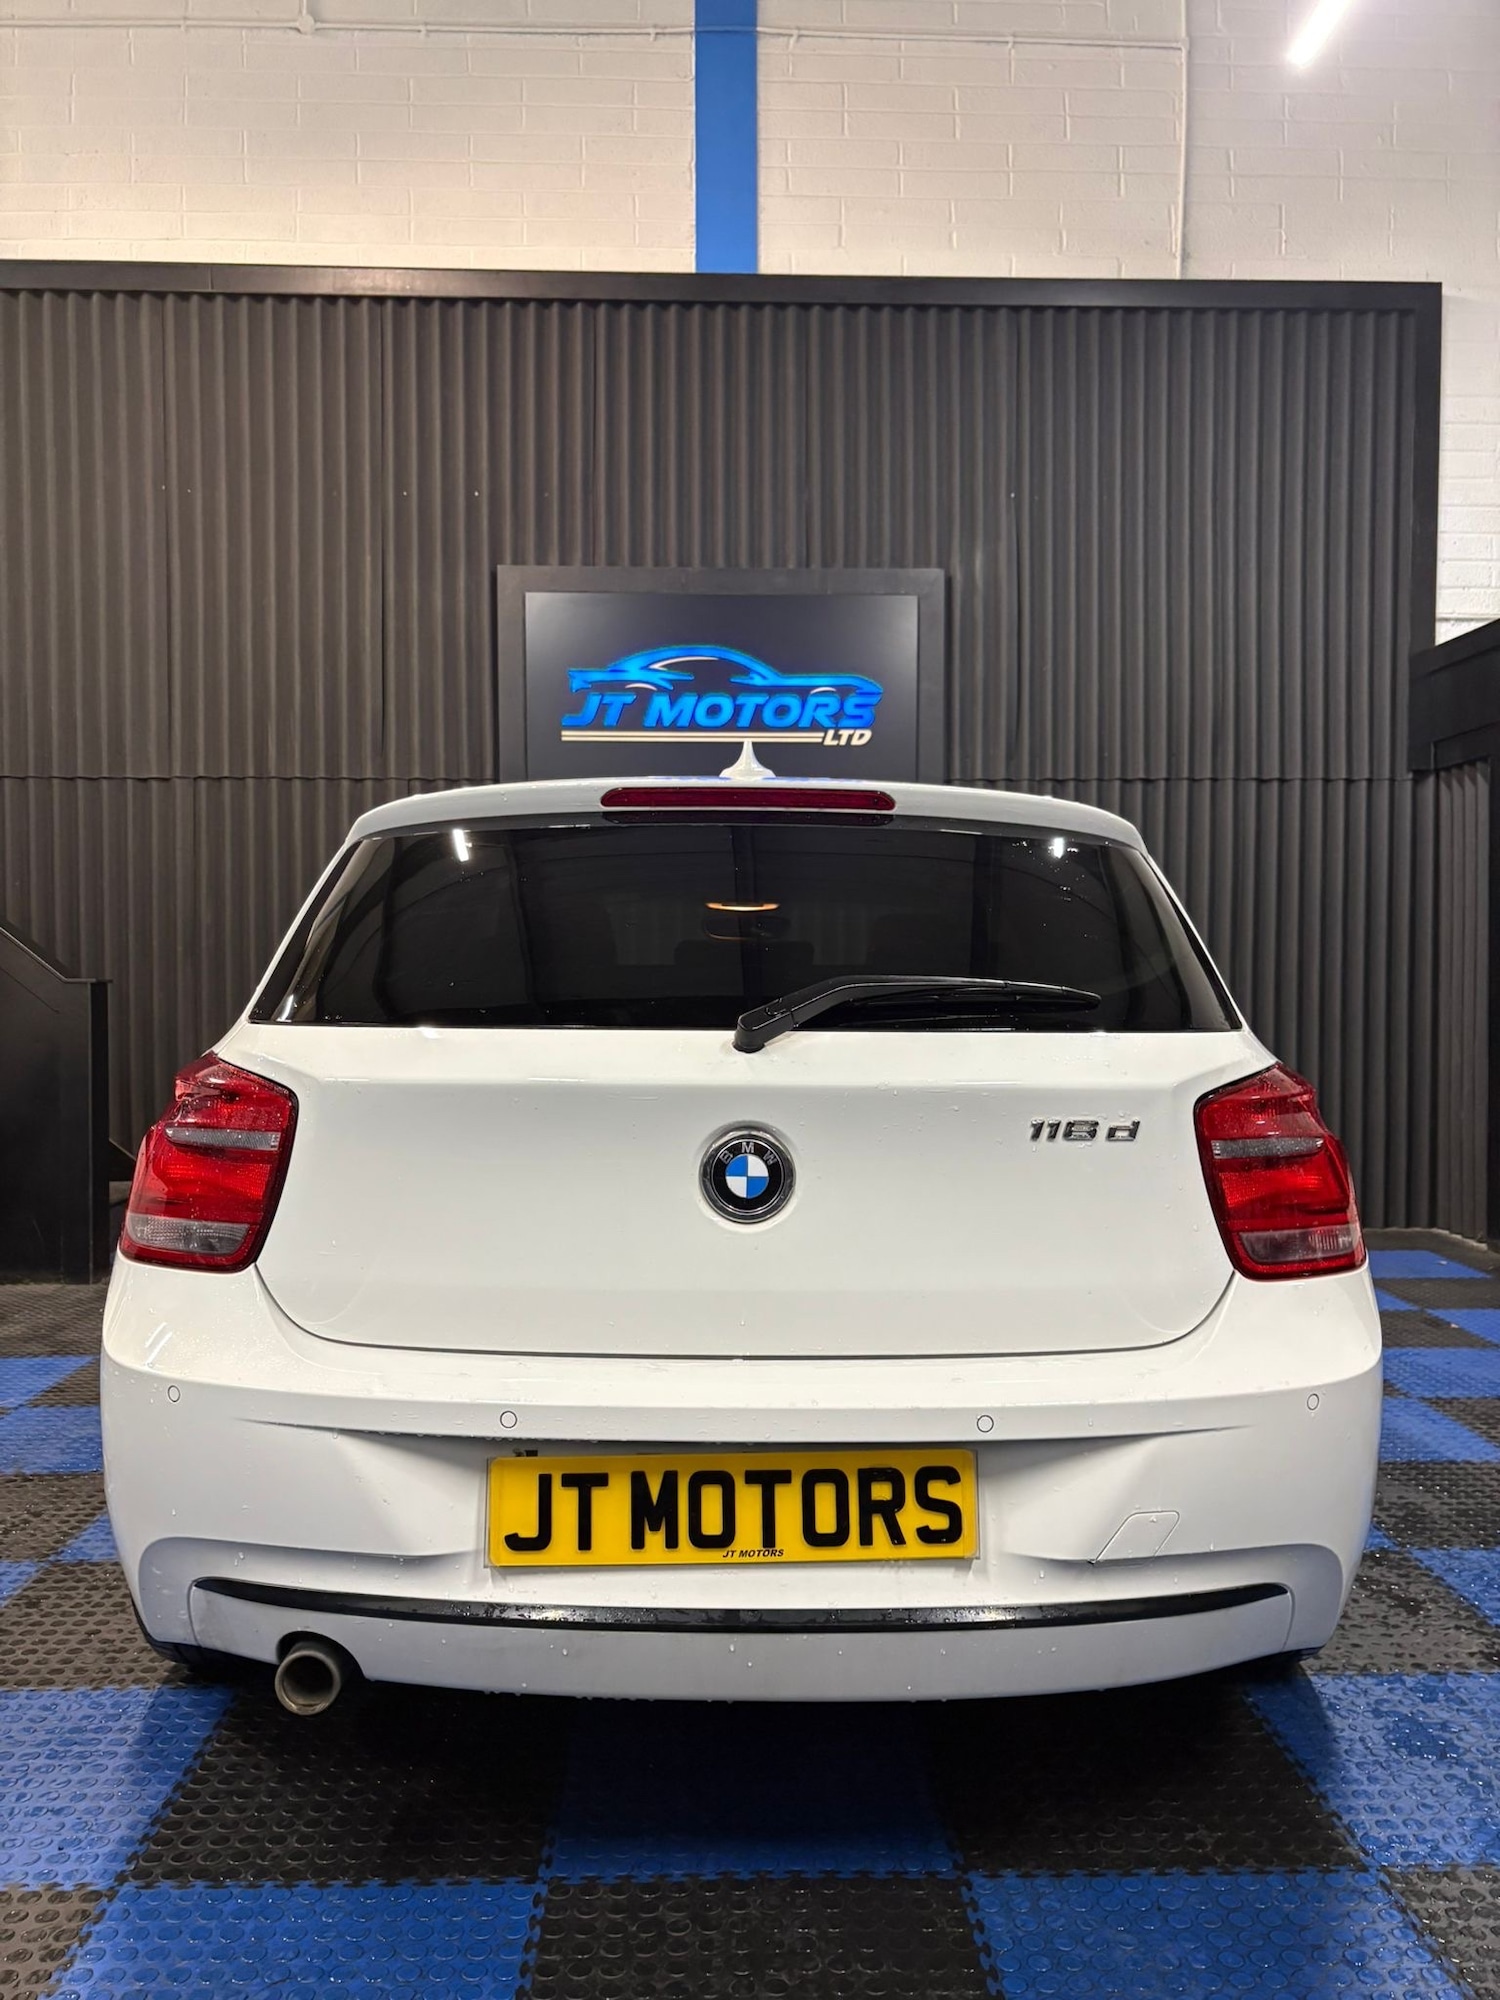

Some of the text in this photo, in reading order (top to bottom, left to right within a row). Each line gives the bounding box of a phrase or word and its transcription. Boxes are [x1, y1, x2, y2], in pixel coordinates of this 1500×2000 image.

[561, 692, 882, 728] JT MOTORS
[823, 728, 873, 746] LTD
[719, 1142, 778, 1165] BMW
[504, 1465, 963, 1551] JT MOTORS
[722, 1549, 785, 1558] JT MOTORS
